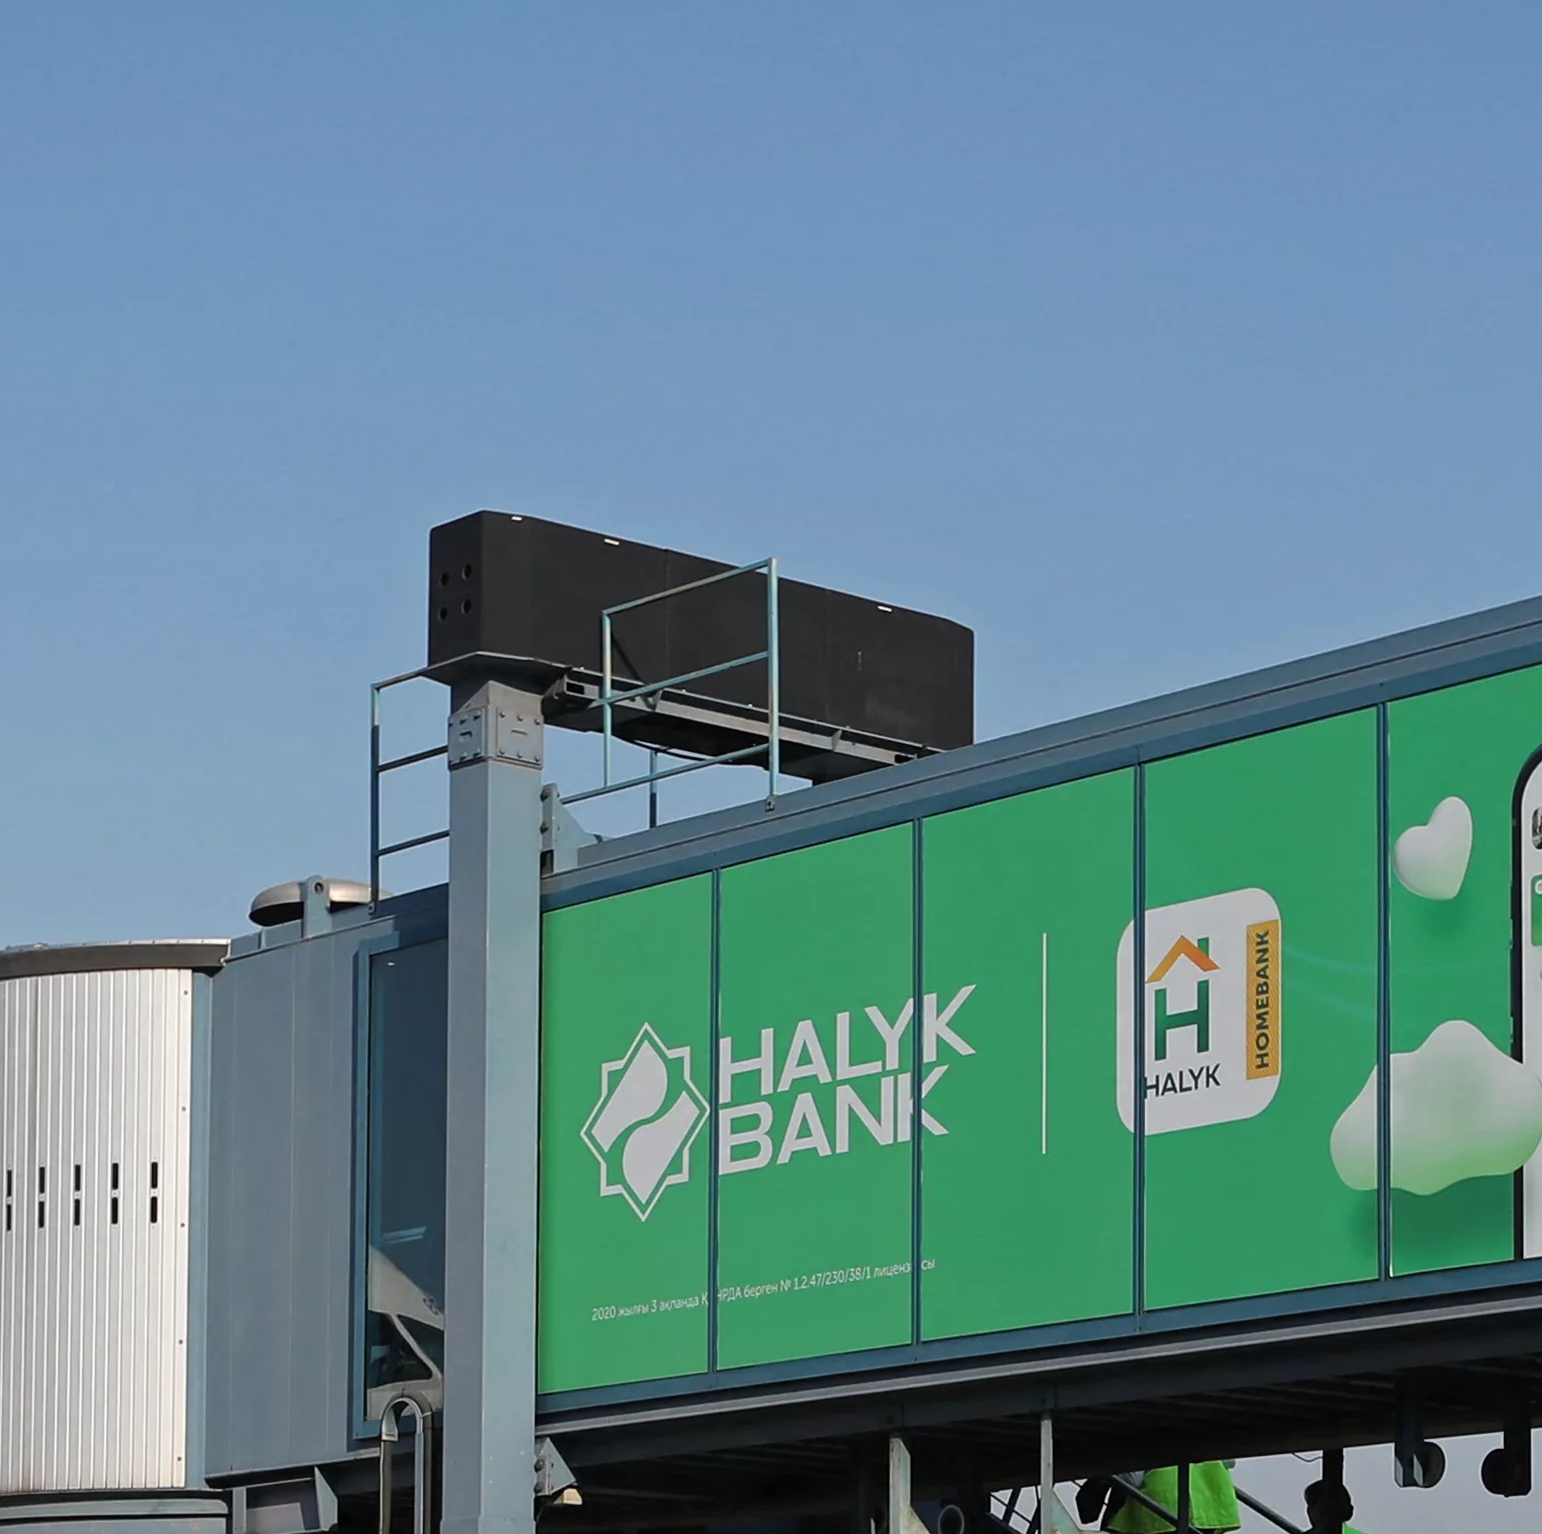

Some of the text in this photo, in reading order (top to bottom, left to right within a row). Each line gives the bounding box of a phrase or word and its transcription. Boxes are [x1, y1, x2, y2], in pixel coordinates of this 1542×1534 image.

[718, 984, 977, 1105] HALYK
[1255, 929, 1270, 1070] HOMEBANK
[718, 1065, 950, 1176] BANK
[1143, 1063, 1221, 1100] HALYK
[591, 1306, 617, 1322] 2020
[651, 1299, 658, 1313] 3
